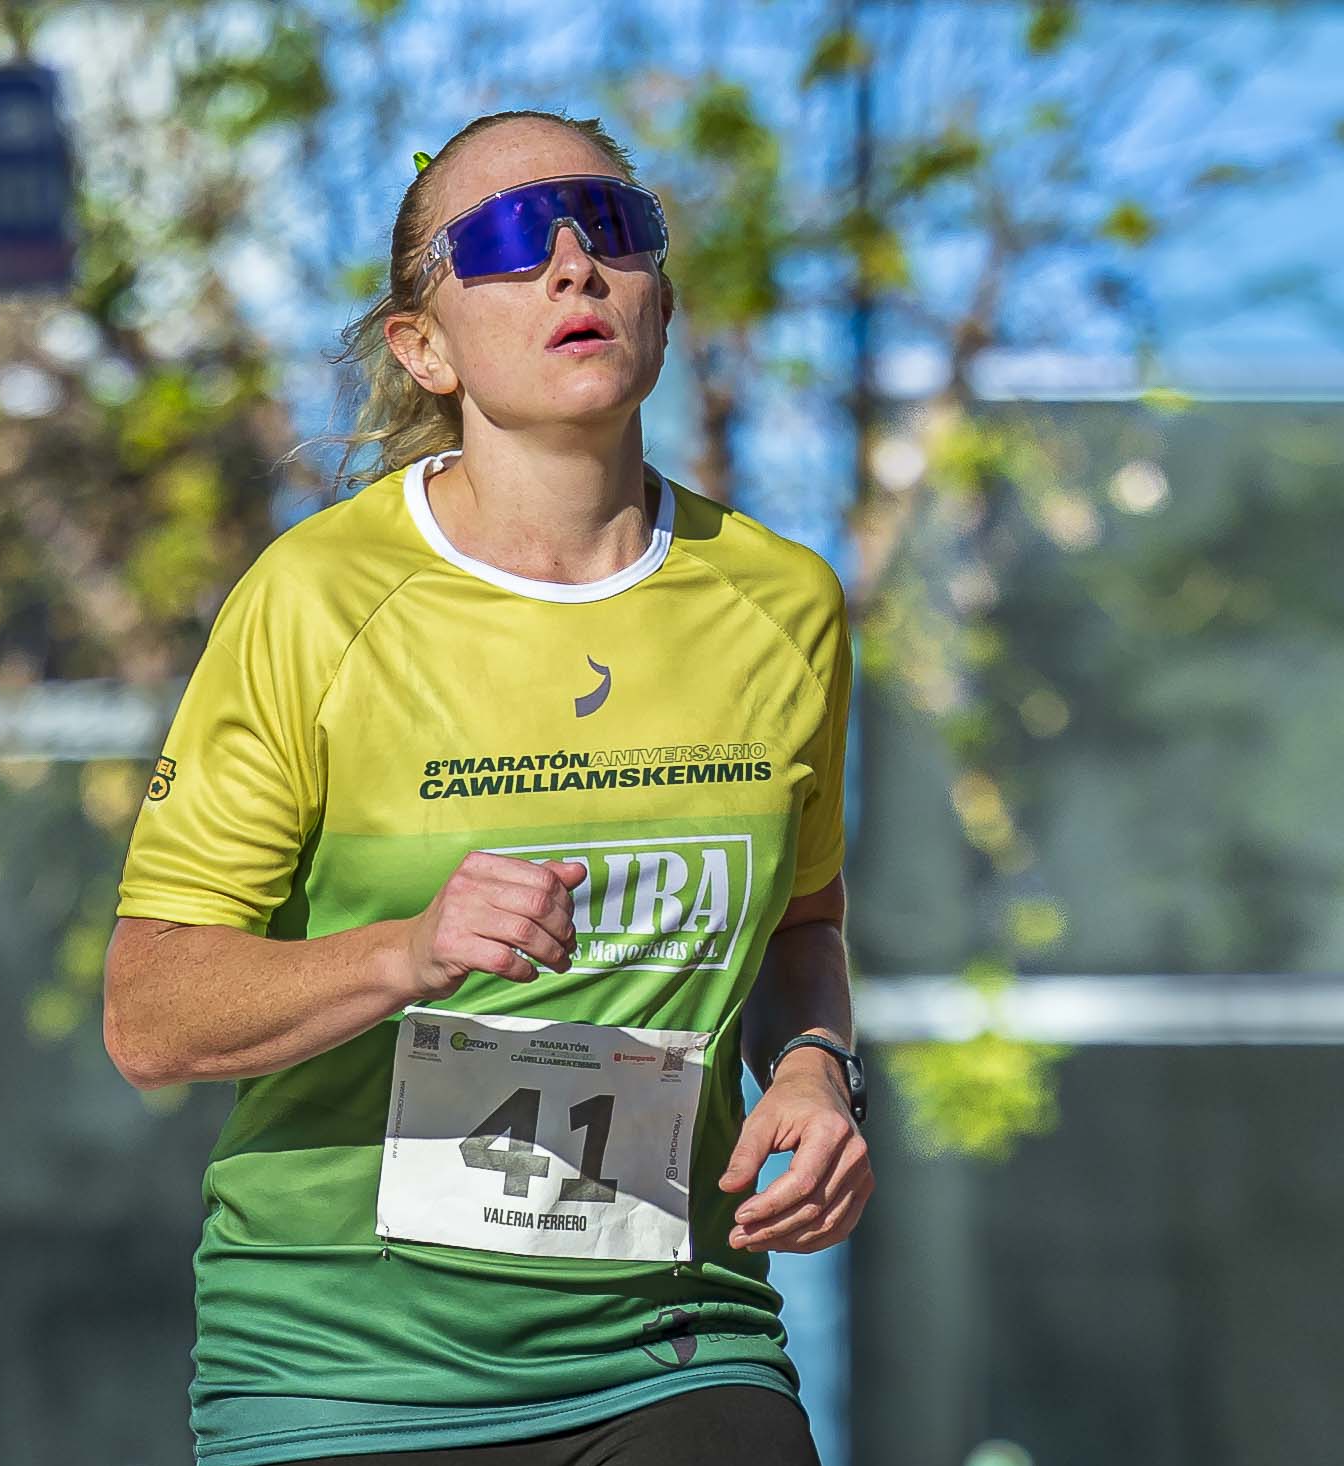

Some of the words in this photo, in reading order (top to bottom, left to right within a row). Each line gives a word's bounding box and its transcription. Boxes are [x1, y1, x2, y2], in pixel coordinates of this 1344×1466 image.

[419, 761, 772, 800] CAWILLIAMSKEMMIS
[587, 938, 688, 964] Mayoristas
[459, 1087, 618, 1204] 41
[483, 1206, 534, 1229] VALERIA
[537, 1213, 587, 1232] FERRERO
